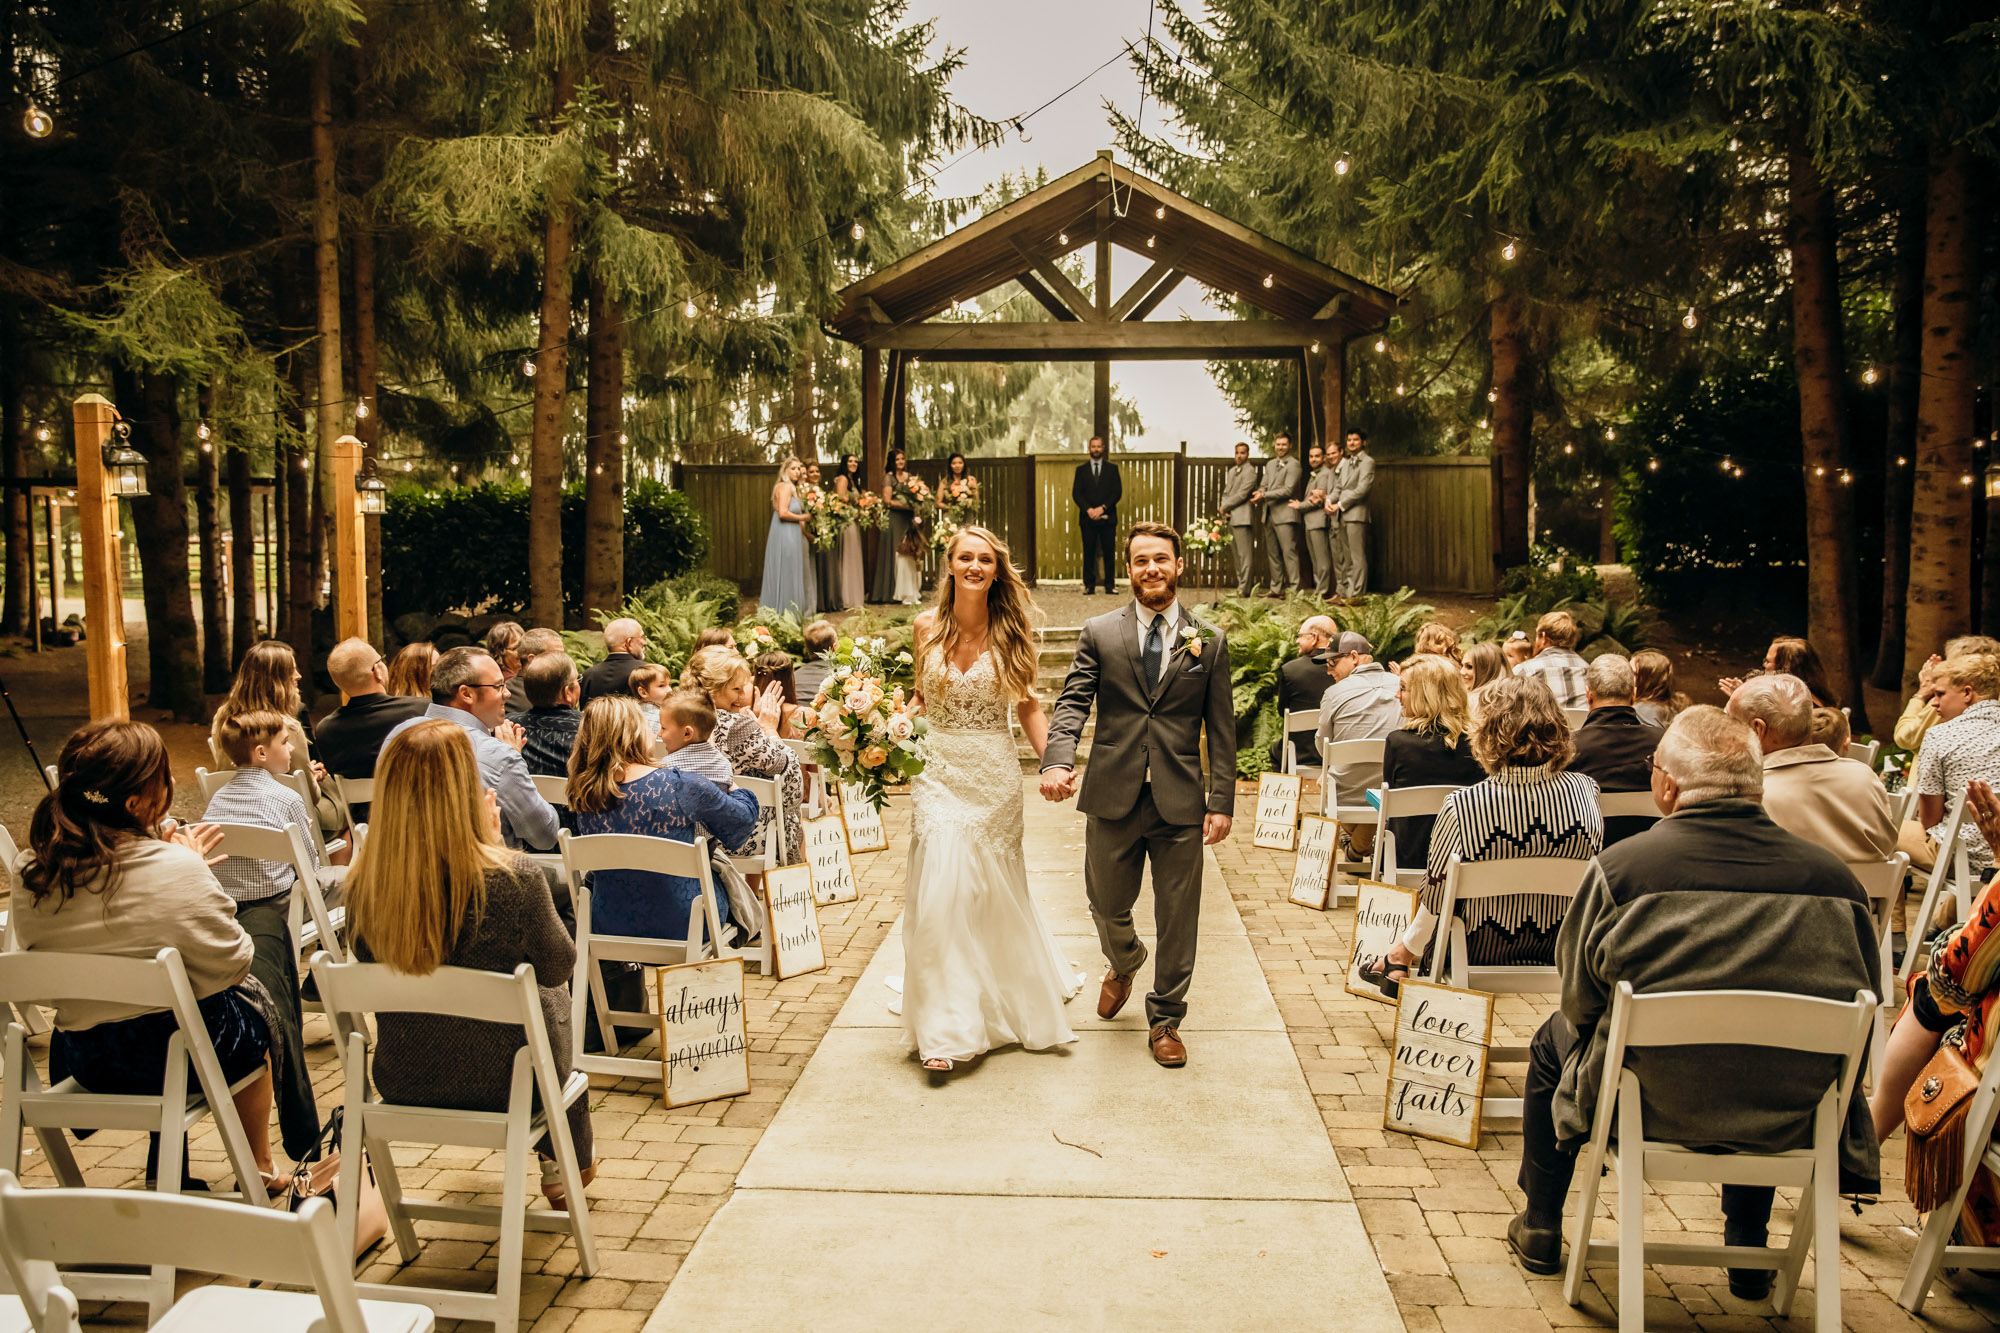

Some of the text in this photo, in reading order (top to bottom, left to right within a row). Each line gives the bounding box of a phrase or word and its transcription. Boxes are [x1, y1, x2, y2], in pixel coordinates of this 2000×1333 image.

[1260, 783, 1297, 798] it does
[853, 805, 870, 820] not
[1264, 803, 1287, 817] not
[813, 829, 841, 845] it is
[853, 826, 879, 842] envy
[1256, 824, 1293, 841] boast
[1314, 822, 1324, 841] it
[818, 850, 839, 867] not
[1299, 836, 1330, 873] always
[815, 868, 850, 893] rude
[772, 883, 813, 919] always
[1357, 897, 1409, 944] always
[780, 925, 816, 951] trusts
[666, 986, 742, 1034] always
[1411, 999, 1474, 1039] love
[666, 1033, 745, 1088] perseveres
[1396, 1045, 1482, 1077] never
[1395, 1079, 1471, 1121] fails
